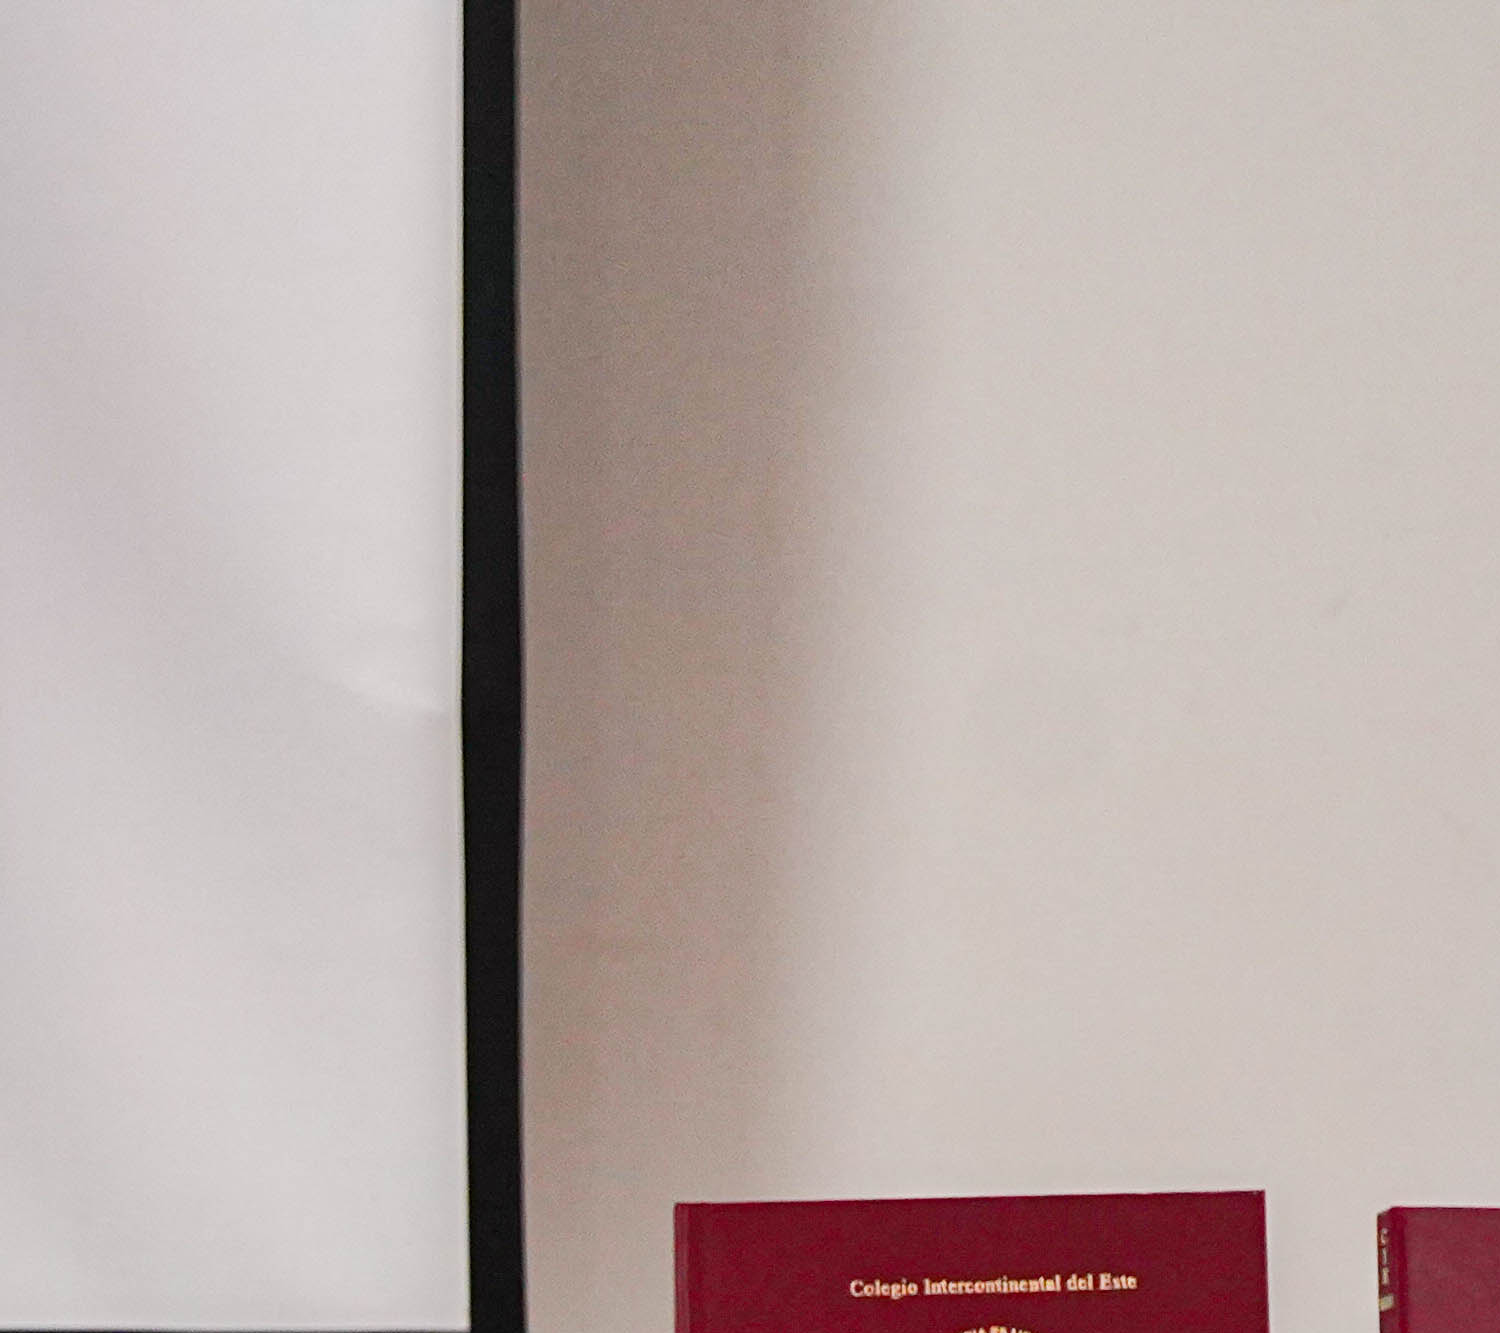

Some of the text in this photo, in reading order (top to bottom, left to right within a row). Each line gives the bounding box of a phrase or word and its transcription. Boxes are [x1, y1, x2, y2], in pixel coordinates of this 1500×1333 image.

[849, 1273, 1138, 1299] Colegio Intercontinental del Este
